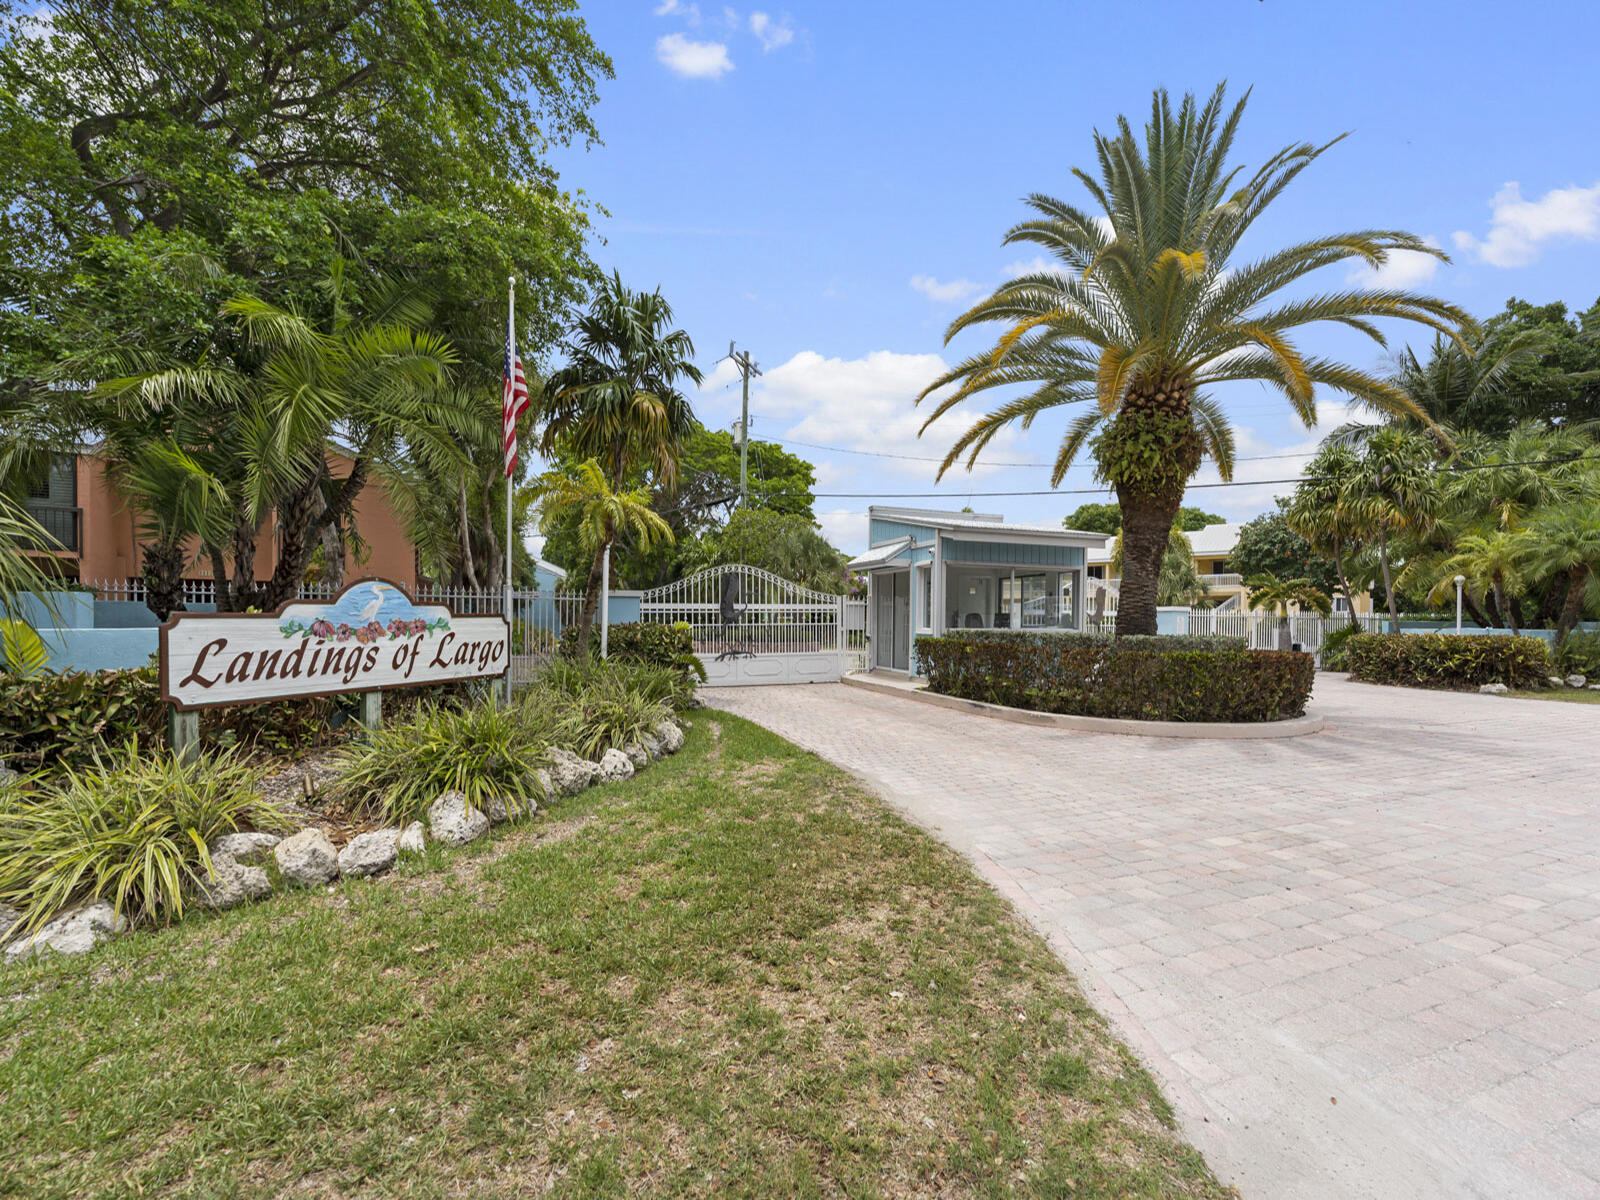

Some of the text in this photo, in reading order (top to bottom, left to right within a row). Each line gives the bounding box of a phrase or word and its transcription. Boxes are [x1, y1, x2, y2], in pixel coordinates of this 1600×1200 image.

[179, 631, 505, 689] Landings of Largo
